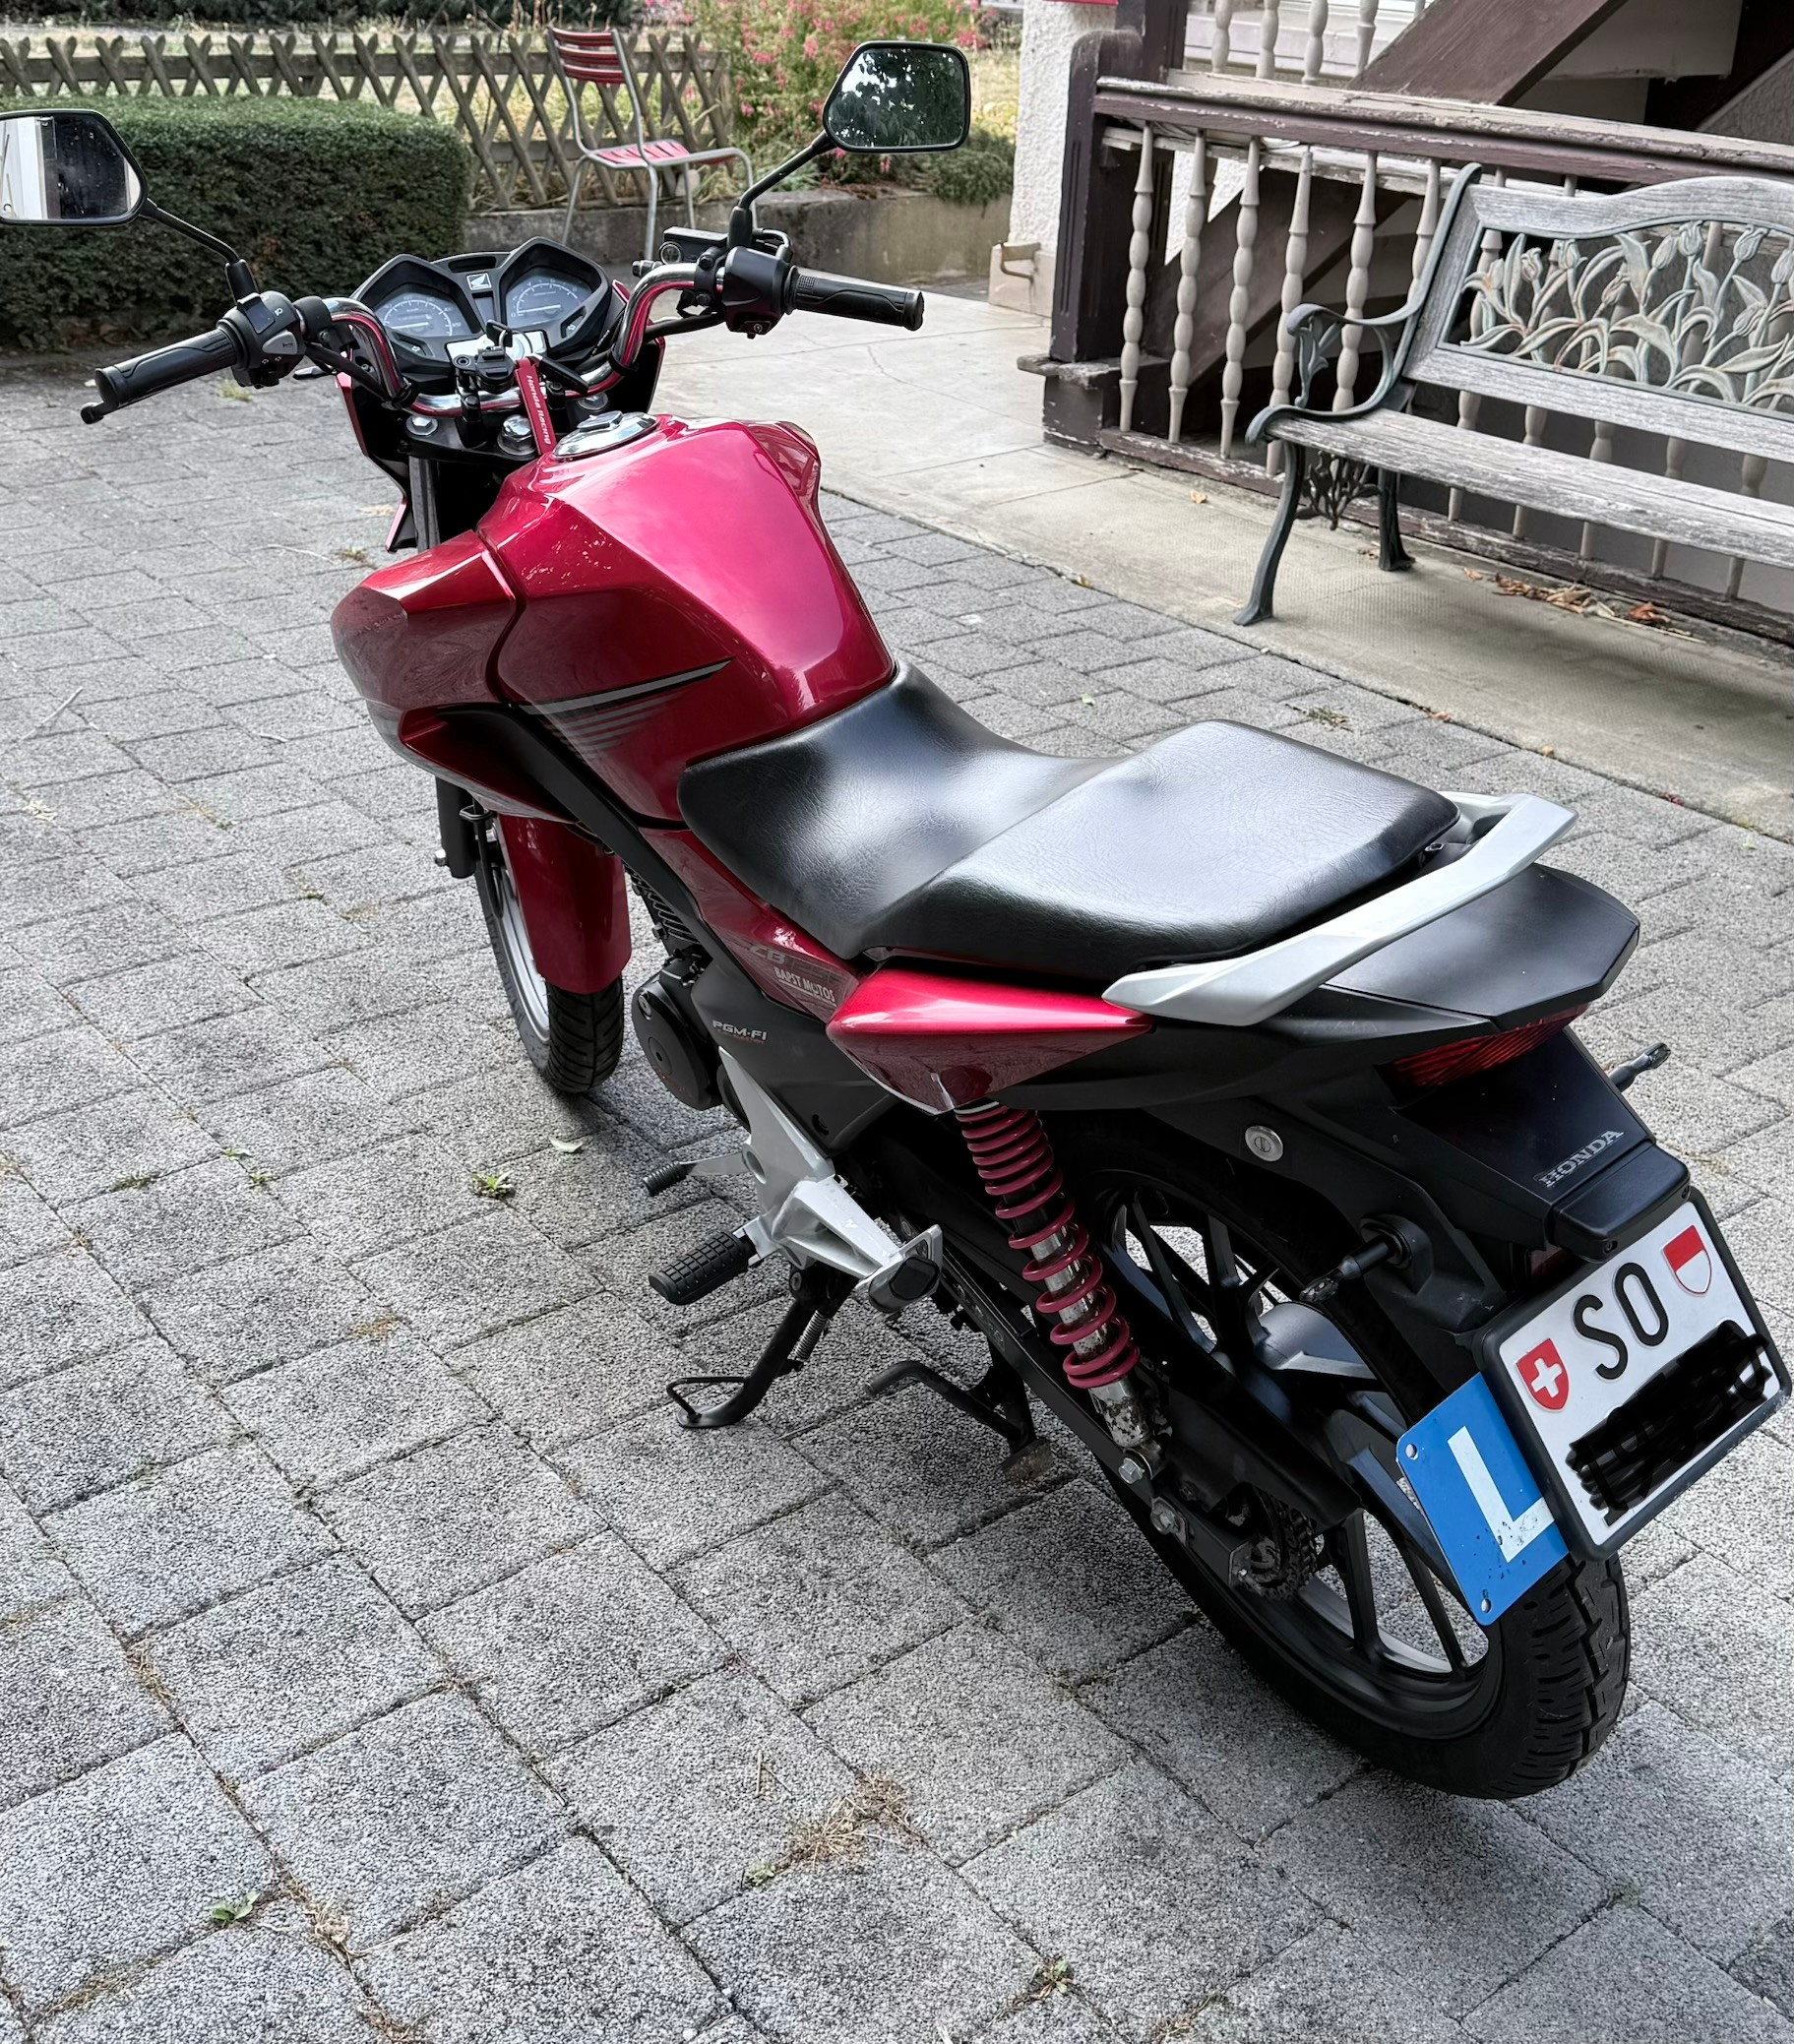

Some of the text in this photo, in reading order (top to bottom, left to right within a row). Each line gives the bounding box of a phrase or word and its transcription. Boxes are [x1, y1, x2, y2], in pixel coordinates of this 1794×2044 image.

[526, 375, 551, 445] Honda Racing
[773, 966, 802, 987] BAPST
[802, 978, 835, 1002] MOTOS
[712, 1020, 768, 1040] PGM-FI
[1538, 1130, 1624, 1187] HONDA
[1574, 1262, 1669, 1380] SO
[1447, 1425, 1555, 1563] L
